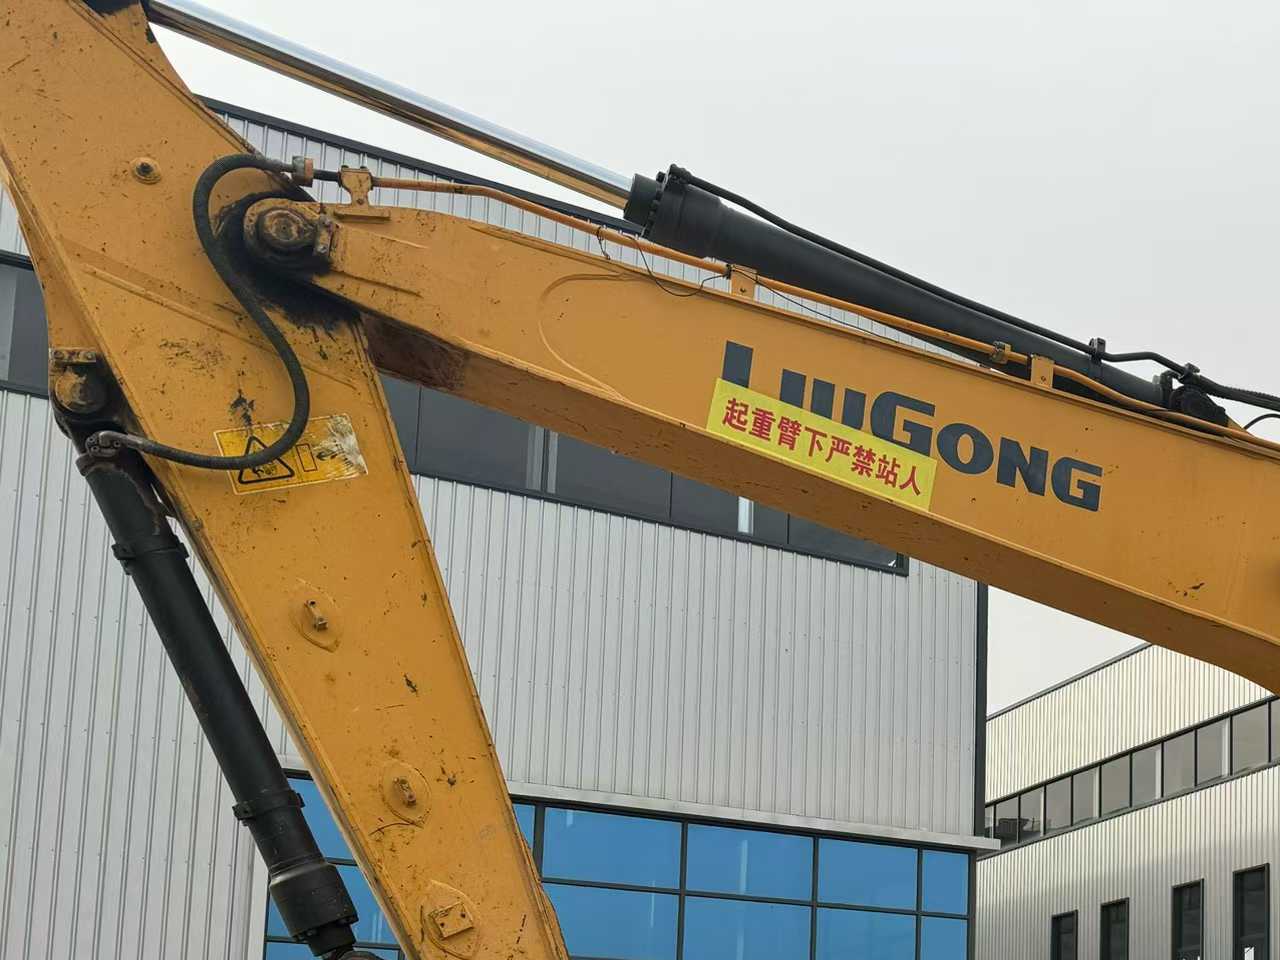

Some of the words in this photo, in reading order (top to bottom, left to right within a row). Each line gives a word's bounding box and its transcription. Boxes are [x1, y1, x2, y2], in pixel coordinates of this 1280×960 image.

[722, 397, 921, 497] 起重臂下严禁站人
